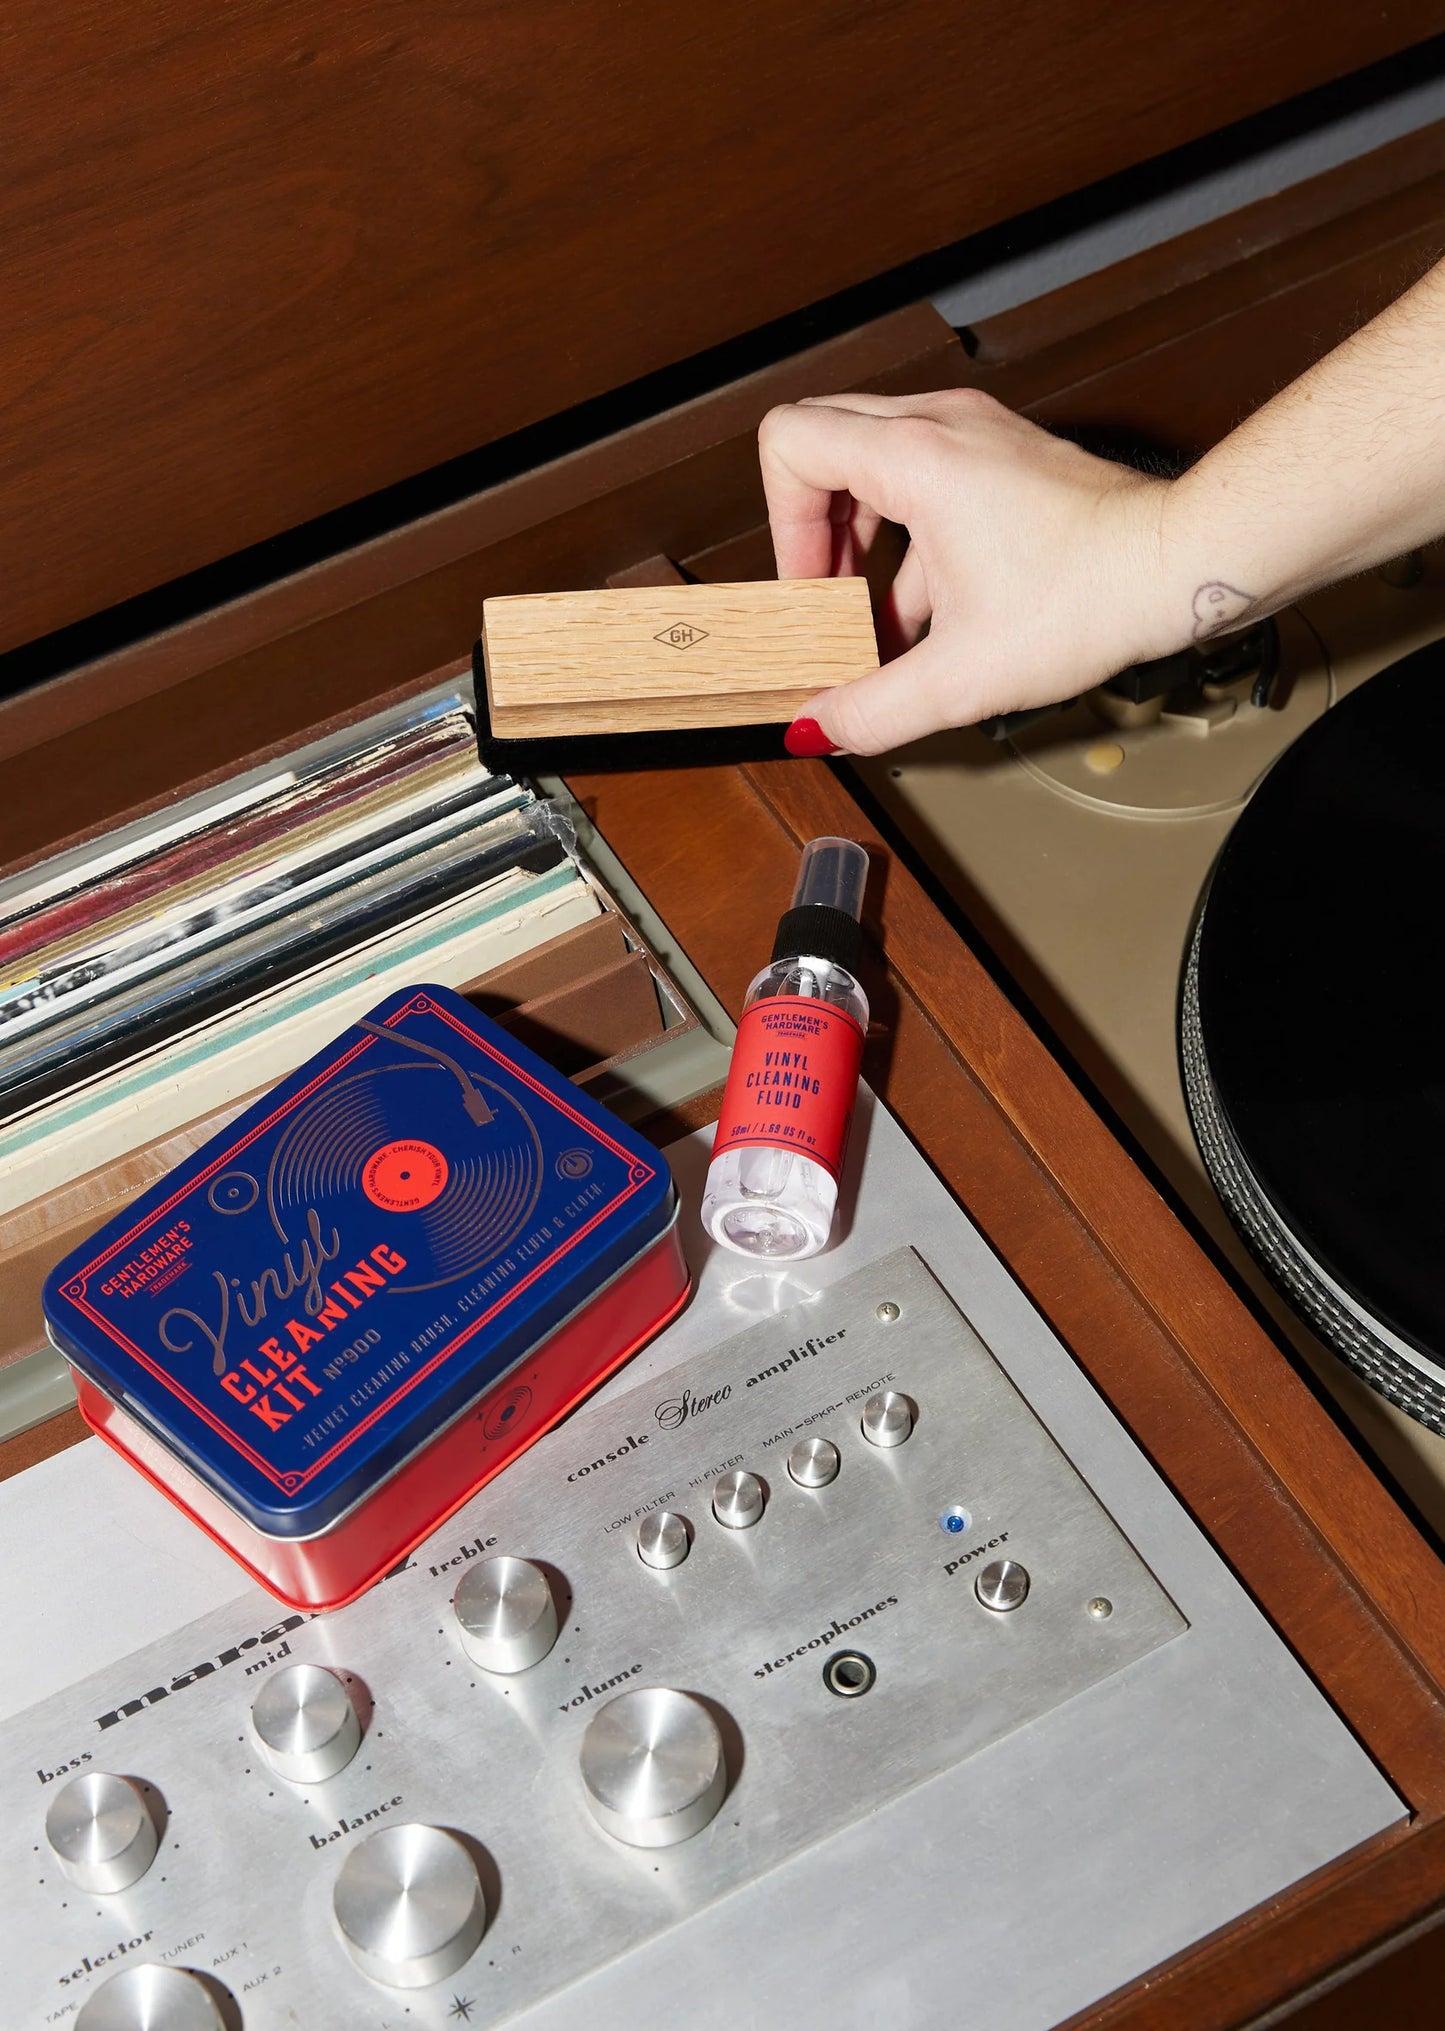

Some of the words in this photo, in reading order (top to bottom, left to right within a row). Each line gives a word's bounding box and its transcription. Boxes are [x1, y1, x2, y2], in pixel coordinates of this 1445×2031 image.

[670, 629, 693, 643] GH
[761, 1013, 829, 1030] GENTLEMEN'S
[765, 1021, 821, 1036] HARDWARE
[765, 1051, 808, 1071] VINYL
[746, 1070, 821, 1095] CLEANING
[757, 1090, 802, 1109] FLUID
[392, 1144, 427, 1155] CHERISH
[730, 1123, 751, 1137] 50ml
[752, 1122, 759, 1133] /
[760, 1123, 781, 1134] 1.69
[783, 1125, 796, 1137] US
[797, 1129, 806, 1140] fl
[806, 1135, 817, 1146] oz
[368, 1152, 388, 1188] HARDWARE
[426, 1151, 441, 1168] YOUR
[431, 1167, 443, 1187] VINYL
[371, 1187, 420, 1207] GENTLEMEN'S
[100, 1220, 191, 1296] GENTLEMEN'S
[119, 1236, 193, 1299] HARDWARE
[149, 1260, 188, 1293] TRADEMARK
[158, 1208, 340, 1377] Vinyl
[219, 1243, 408, 1405] CLEANING
[350, 1351, 411, 1407] CLEANING
[410, 1314, 459, 1354] BRUSH,
[457, 1258, 517, 1313] CLEANING
[516, 1226, 553, 1261] FLUID
[552, 1216, 566, 1229] &
[248, 1364, 323, 1433] KIT
[566, 1432, 651, 1483] console
[654, 1384, 733, 1431] Stereo
[745, 1326, 848, 1389] amplifier
[762, 1427, 794, 1448] MAIN
[845, 1372, 897, 1404] REMOTE
[703, 1453, 745, 1481] FILTER
[603, 1514, 632, 1535] LOW
[634, 1490, 677, 1518] FILTER
[428, 1535, 499, 1578] treble
[943, 1529, 1011, 1576] power
[752, 1593, 900, 1680] stereophones
[244, 1641, 293, 1677] mid
[556, 1661, 644, 1713] volume
[36, 1749, 94, 1785] bass
[308, 1793, 405, 1851] balance
[58, 1928, 154, 1987] selector
[159, 1932, 206, 1961] TUNER
[211, 1946, 240, 1967] AUX
[241, 1974, 270, 1993] AUX
[273, 1965, 283, 1976] 2
[44, 2001, 79, 2025] TAPE
